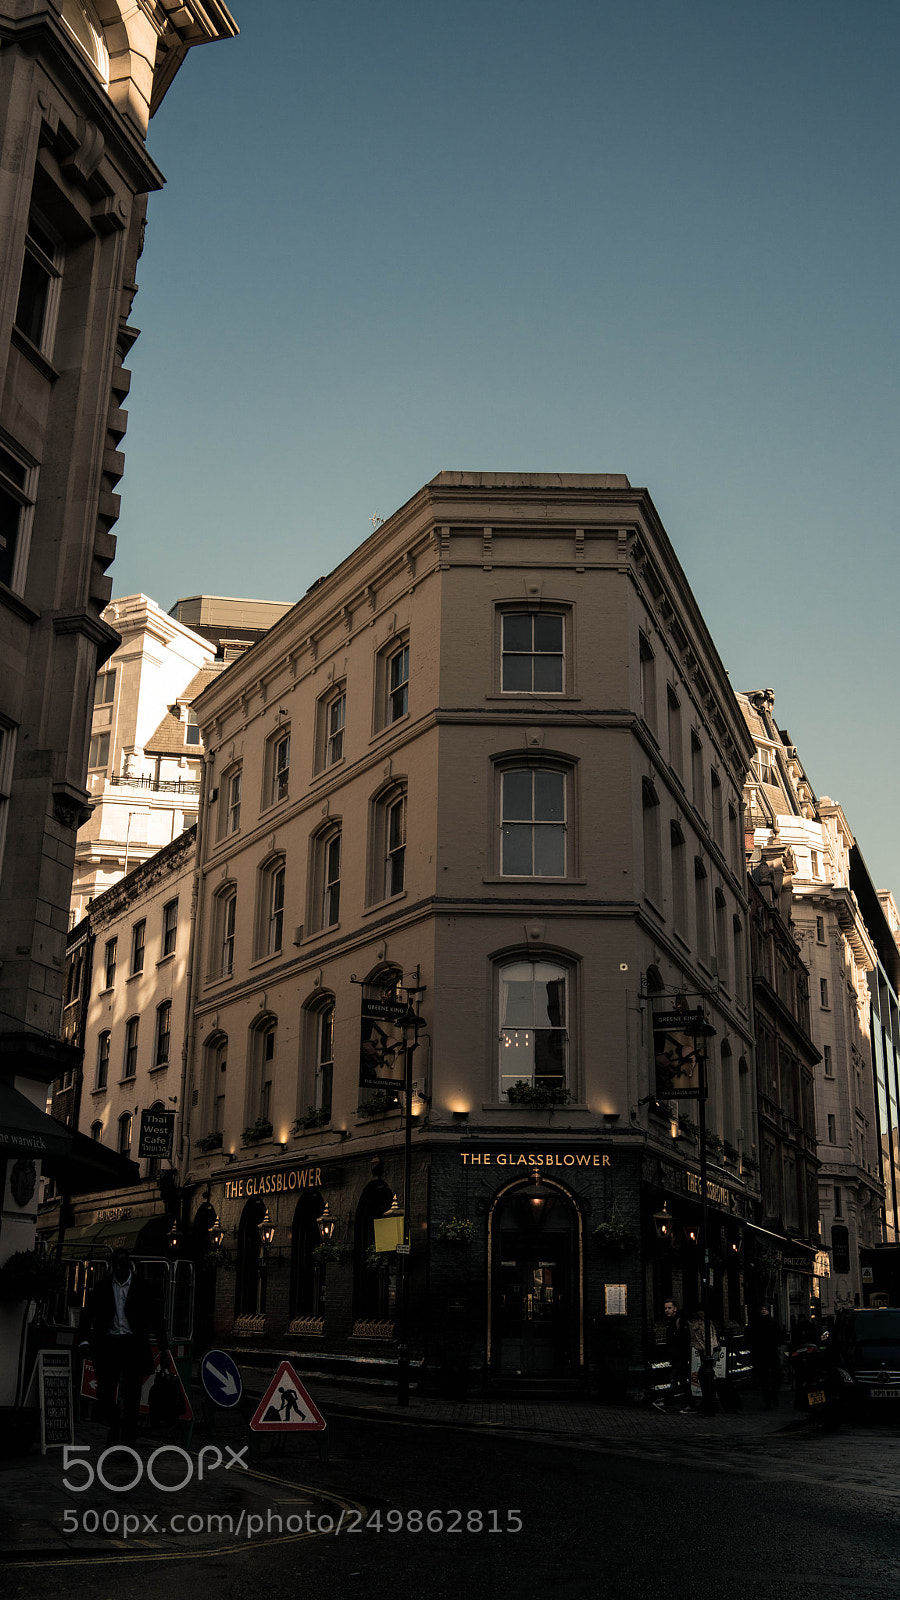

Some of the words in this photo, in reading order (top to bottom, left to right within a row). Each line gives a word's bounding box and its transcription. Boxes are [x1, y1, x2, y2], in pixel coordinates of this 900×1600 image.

[367, 1004, 389, 1012] GREENE
[390, 1006, 404, 1014] KING
[658, 1015, 682, 1023] GREENE
[147, 1115, 168, 1124] Thai
[143, 1125, 169, 1134] West
[10, 1135, 47, 1150] warwick
[144, 1136, 166, 1145] Cafe
[460, 1152, 490, 1165] THE
[496, 1153, 612, 1167] GLASSBLOWER
[225, 1180, 244, 1199] THE
[245, 1167, 323, 1196] GLASSBLOWER
